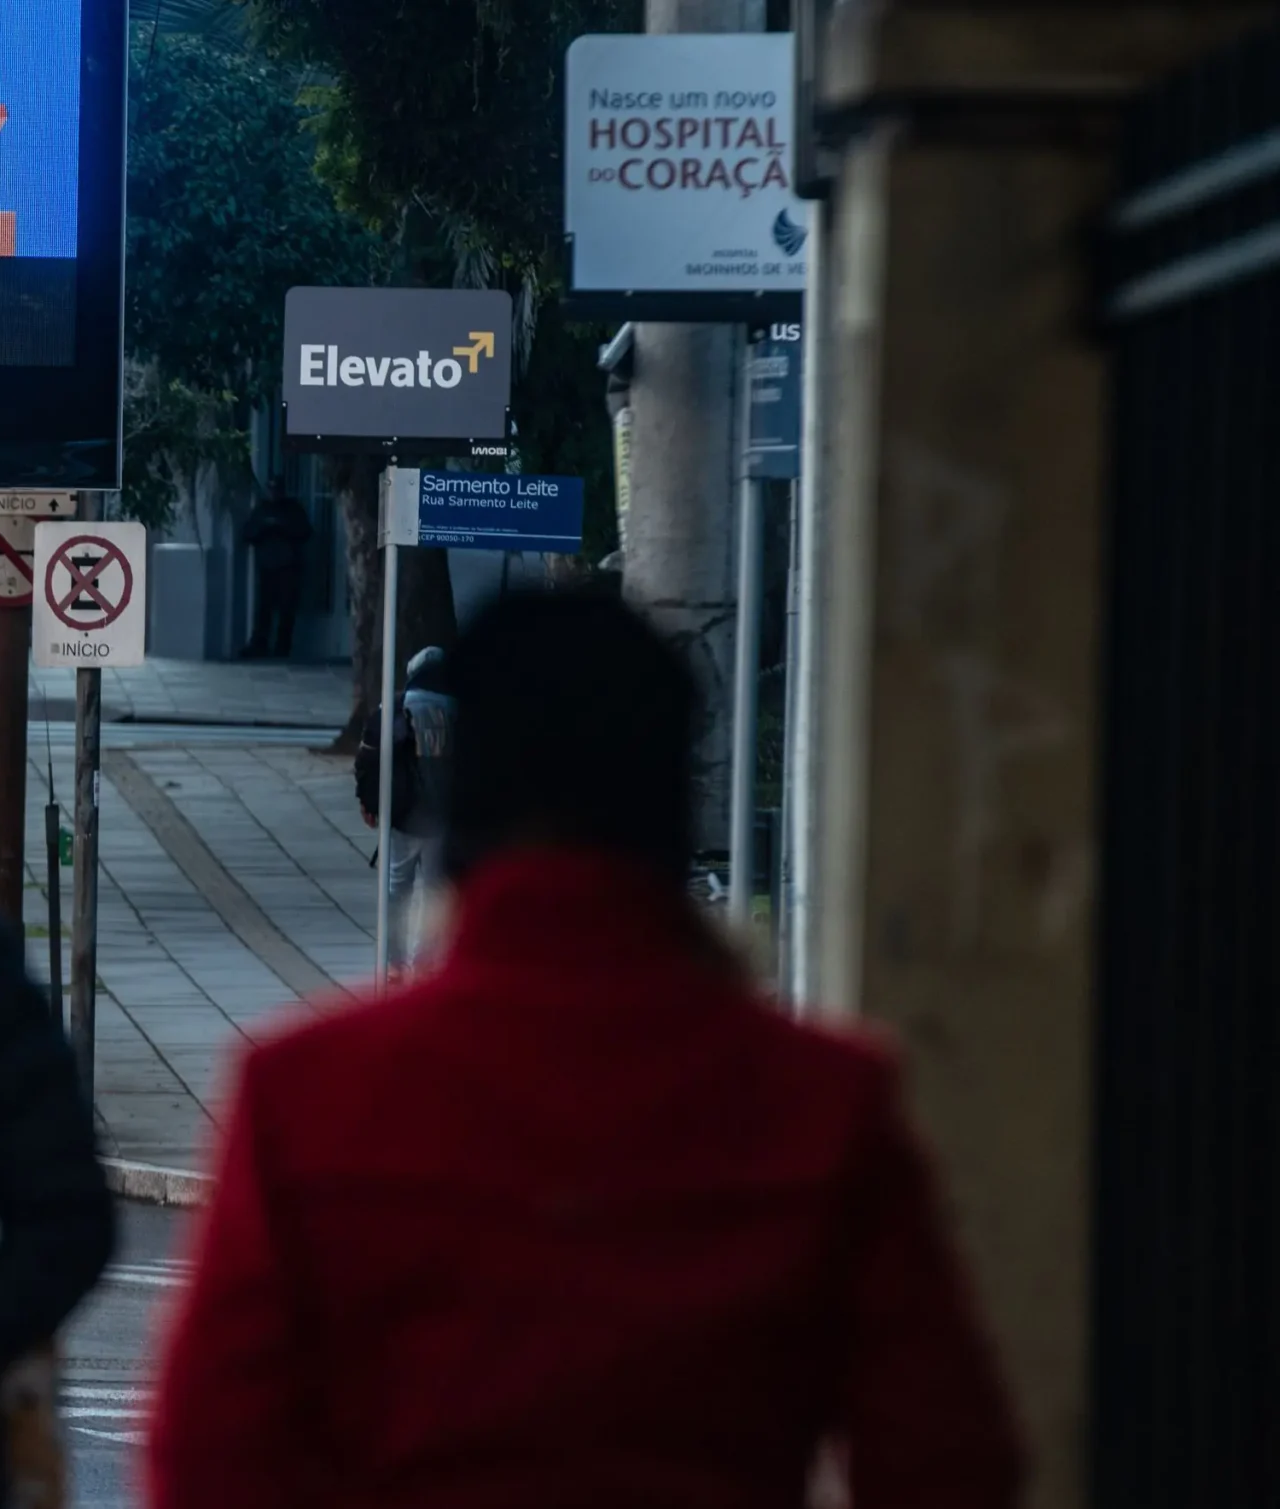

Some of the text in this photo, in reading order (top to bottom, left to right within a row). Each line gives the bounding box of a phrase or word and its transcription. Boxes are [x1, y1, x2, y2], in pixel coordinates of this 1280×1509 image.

[589, 88, 777, 110] Nasce um novo
[589, 117, 787, 150] HOSPITAL
[618, 151, 789, 199] CORAÇÃ
[299, 343, 463, 389] Elevato
[422, 475, 560, 497] Sarmento Leite
[422, 494, 539, 510] Rua Sarmento Leite
[61, 640, 111, 657] INÍCIO
